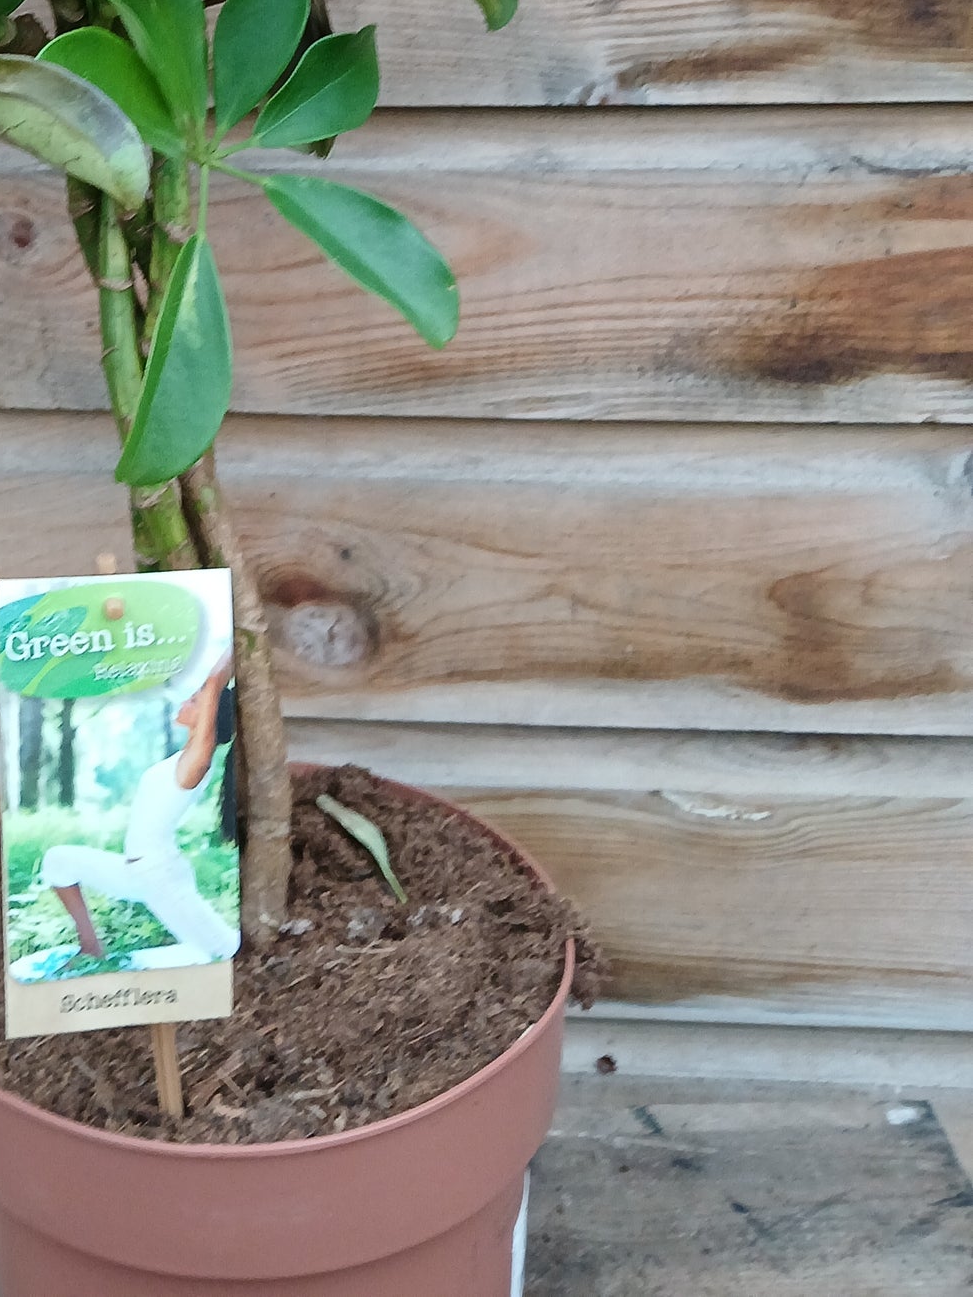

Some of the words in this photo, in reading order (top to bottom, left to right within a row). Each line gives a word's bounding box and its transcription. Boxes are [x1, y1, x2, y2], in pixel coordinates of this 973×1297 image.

[5, 628, 115, 662] Green
[123, 621, 186, 649] is...
[60, 987, 178, 1014] Schefflera
